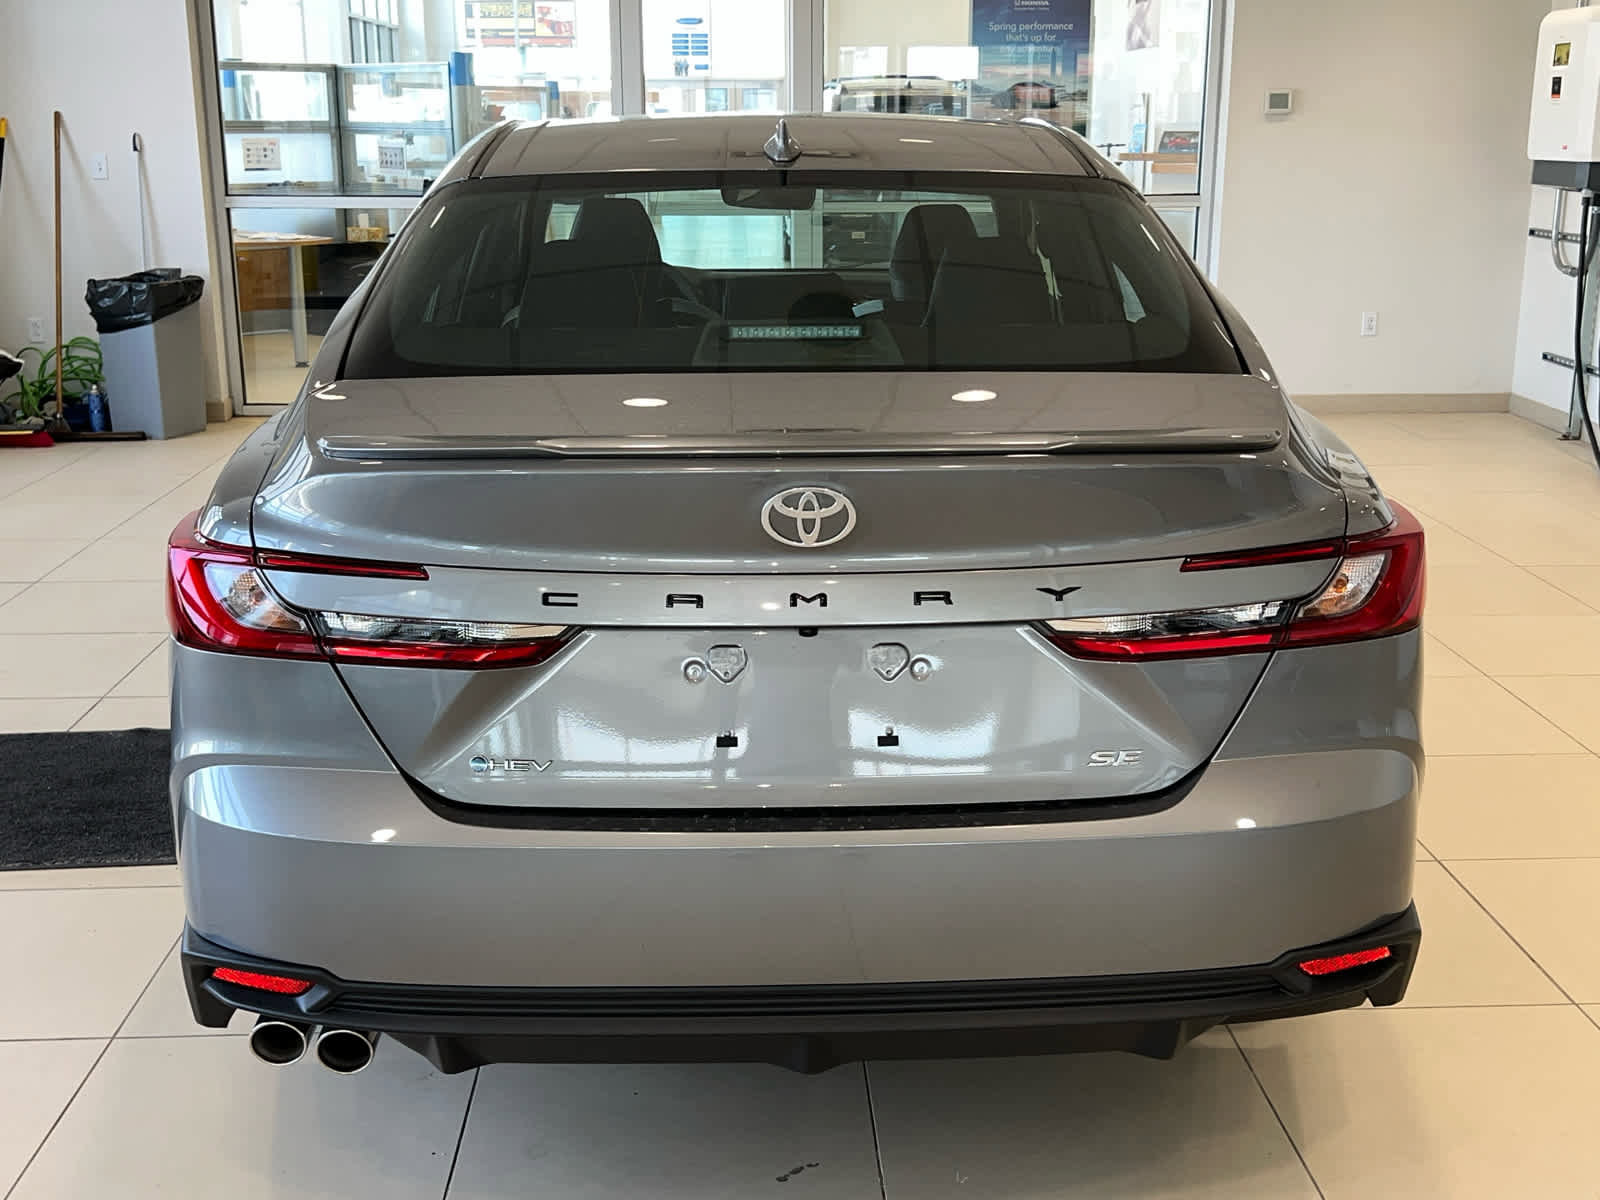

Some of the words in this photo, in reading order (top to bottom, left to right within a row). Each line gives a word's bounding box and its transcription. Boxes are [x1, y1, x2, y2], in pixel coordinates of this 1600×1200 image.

[988, 23, 1016, 32] Spring
[1019, 21, 1074, 32] performance
[1006, 33, 1028, 41] that's
[1044, 33, 1057, 41] for
[541, 586, 1082, 609] CAMRY
[488, 758, 552, 772] HEV
[1087, 749, 1144, 767] SE
